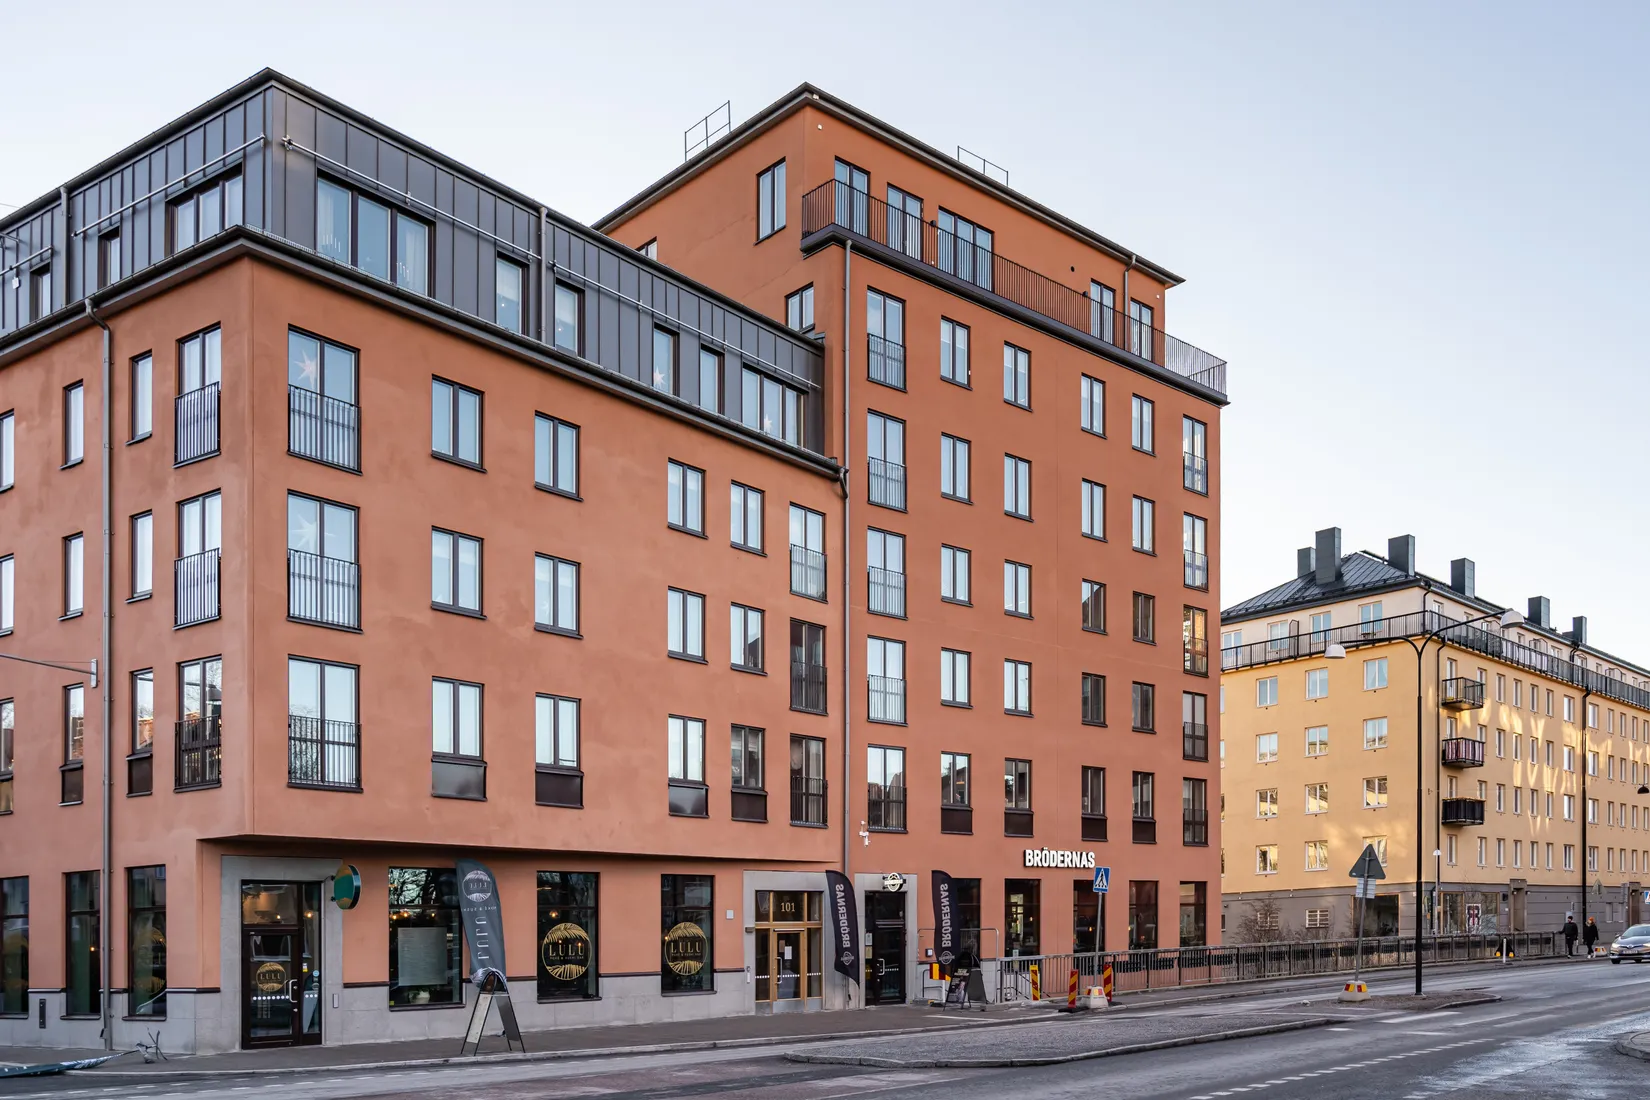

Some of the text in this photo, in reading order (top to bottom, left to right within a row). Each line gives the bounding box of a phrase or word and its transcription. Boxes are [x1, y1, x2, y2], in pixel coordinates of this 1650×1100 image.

[1024, 847, 1096, 868] BRÖDERNAS
[780, 902, 796, 912] 101
[549, 944, 585, 956] LULU
[671, 941, 702, 953] LULU
